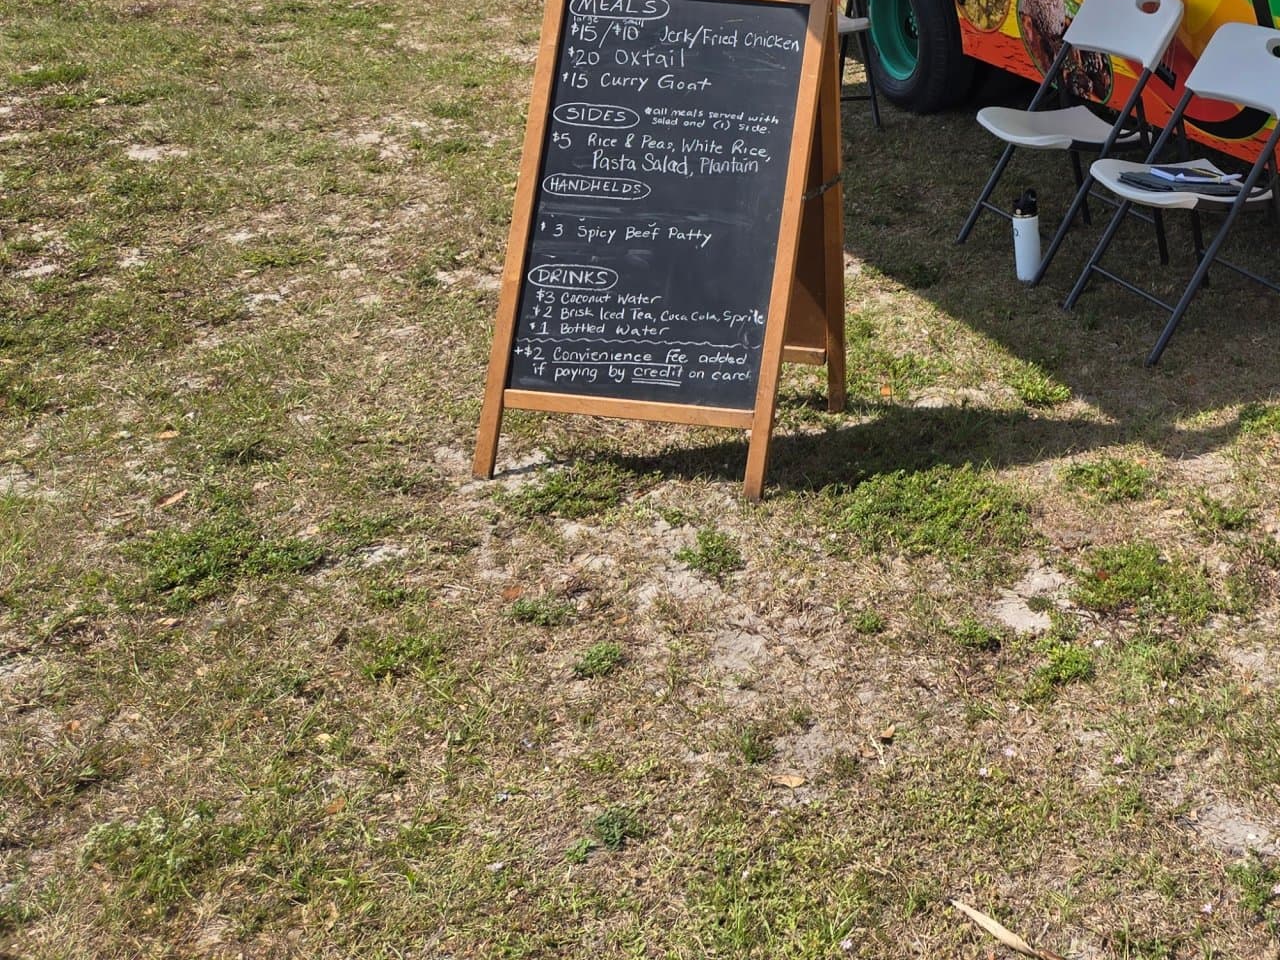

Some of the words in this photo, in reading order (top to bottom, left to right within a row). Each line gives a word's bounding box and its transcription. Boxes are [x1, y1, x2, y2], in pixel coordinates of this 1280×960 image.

[744, 31, 800, 52] Chicken
[568, 46, 600, 66] $20
[562, 72, 589, 89] $15
[600, 72, 649, 92] Curry
[657, 74, 712, 91] Goat
[566, 107, 627, 122] SIDES
[671, 108, 704, 118] meals
[708, 111, 745, 121] served
[748, 112, 780, 125] with
[683, 119, 706, 128] and
[552, 130, 572, 149] $5
[587, 132, 618, 148] Rice
[624, 133, 635, 148] &
[681, 137, 724, 154] White
[592, 148, 637, 172] Pasta
[700, 156, 759, 175] Plantain
[550, 177, 642, 194] HANDHELDS
[577, 225, 617, 244] Spicy
[625, 225, 661, 241] Beef
[668, 226, 712, 249] Patty
[538, 268, 609, 285] DRINKS
[535, 288, 556, 305] $3
[560, 291, 611, 305] Coconut
[617, 293, 662, 305] Water
[532, 304, 553, 318] $2
[560, 307, 594, 321] Brisk
[600, 306, 625, 321] Iced
[529, 321, 550, 335] $1
[560, 322, 606, 335] Bottled
[616, 323, 670, 336] Water
[699, 351, 748, 365] added
[532, 361, 548, 377] if
[554, 367, 598, 383] paying
[608, 364, 626, 383] by
[633, 365, 683, 378] credit
[689, 370, 705, 379] on
[711, 370, 752, 381] card
